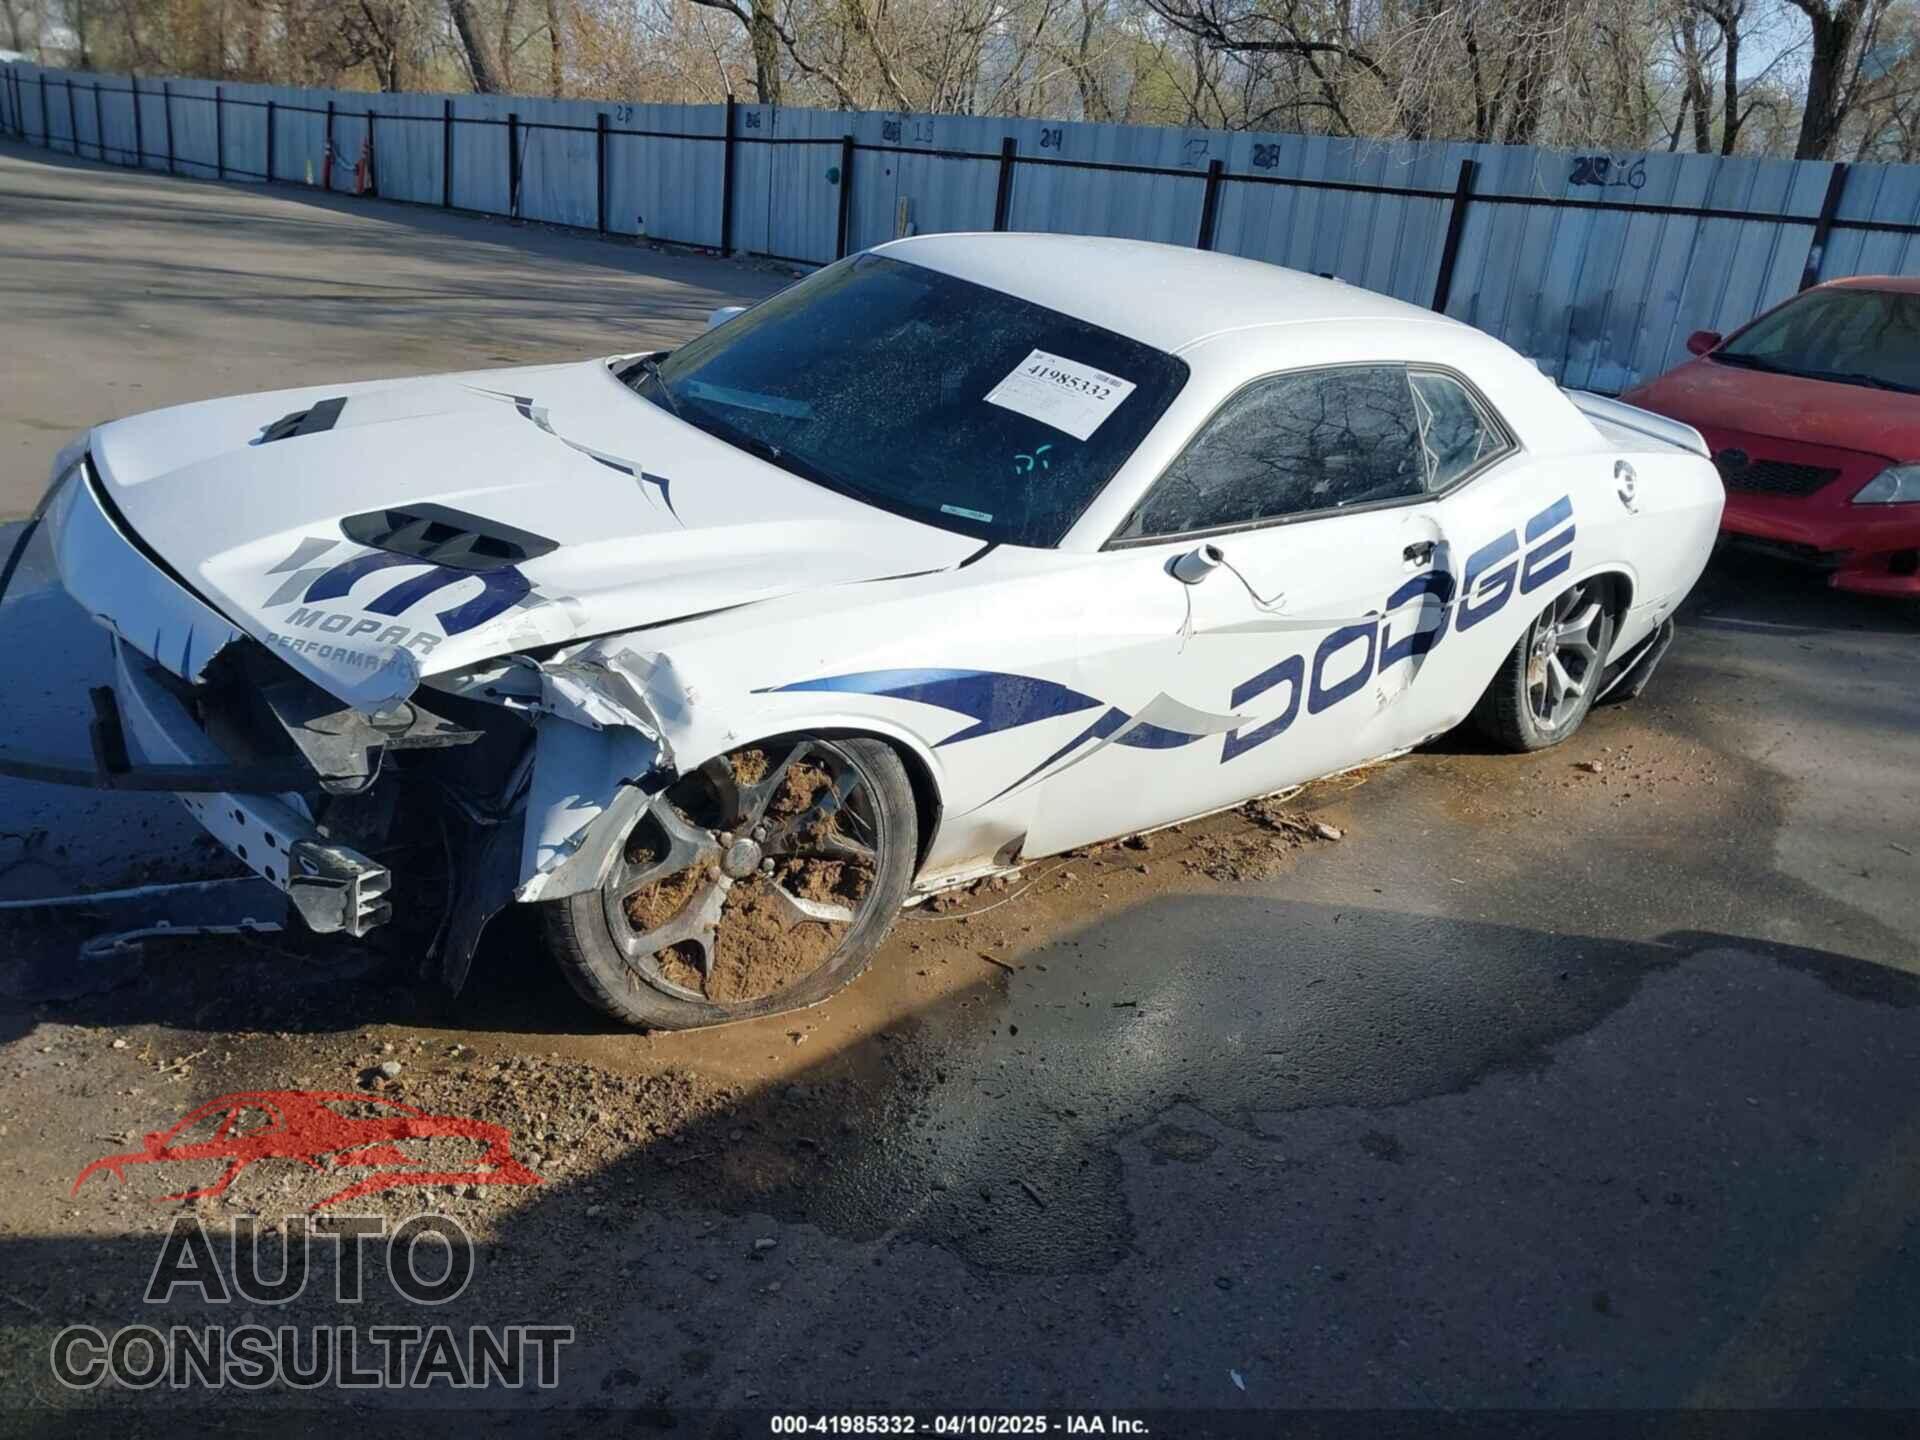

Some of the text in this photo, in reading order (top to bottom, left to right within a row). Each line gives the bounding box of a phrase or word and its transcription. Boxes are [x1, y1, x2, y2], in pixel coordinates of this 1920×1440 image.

[1028, 364, 1111, 400] 41985332
[284, 607, 443, 656] MOPAR
[1220, 494, 1576, 764] DODGE
